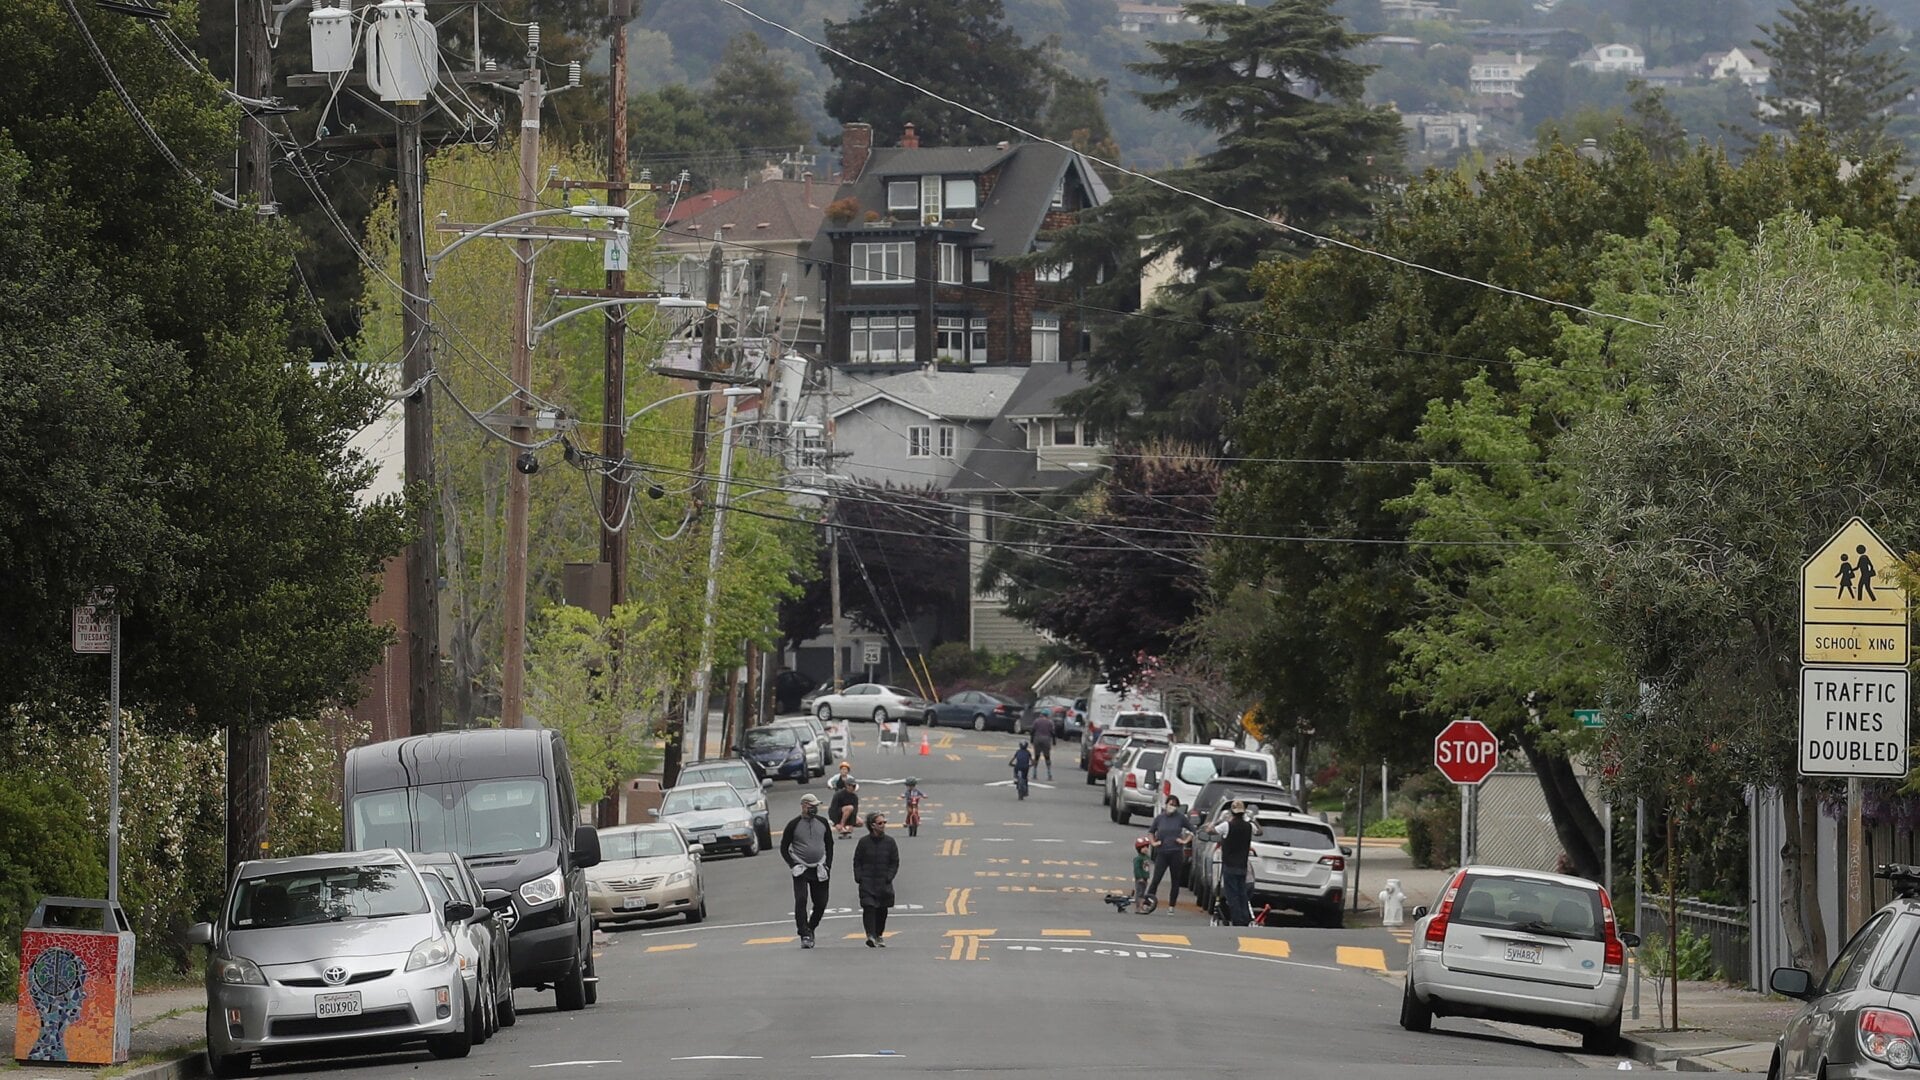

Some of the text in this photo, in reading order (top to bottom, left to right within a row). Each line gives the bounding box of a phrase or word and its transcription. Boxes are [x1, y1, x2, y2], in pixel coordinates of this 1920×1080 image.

[80, 633, 110, 641] TUESDAYS
[1815, 637, 1895, 650] SCHOOL XING
[865, 653, 878, 662] 25
[1814, 682, 1896, 703] TRAFFIC
[1826, 712, 1883, 731] FINES
[1439, 740, 1495, 764] STOP
[1809, 741, 1898, 761] DOUBLED
[974, 871, 1135, 882] SCHOO
[1006, 945, 1173, 958] STOP
[319, 1000, 358, 1014] 8GUX902
